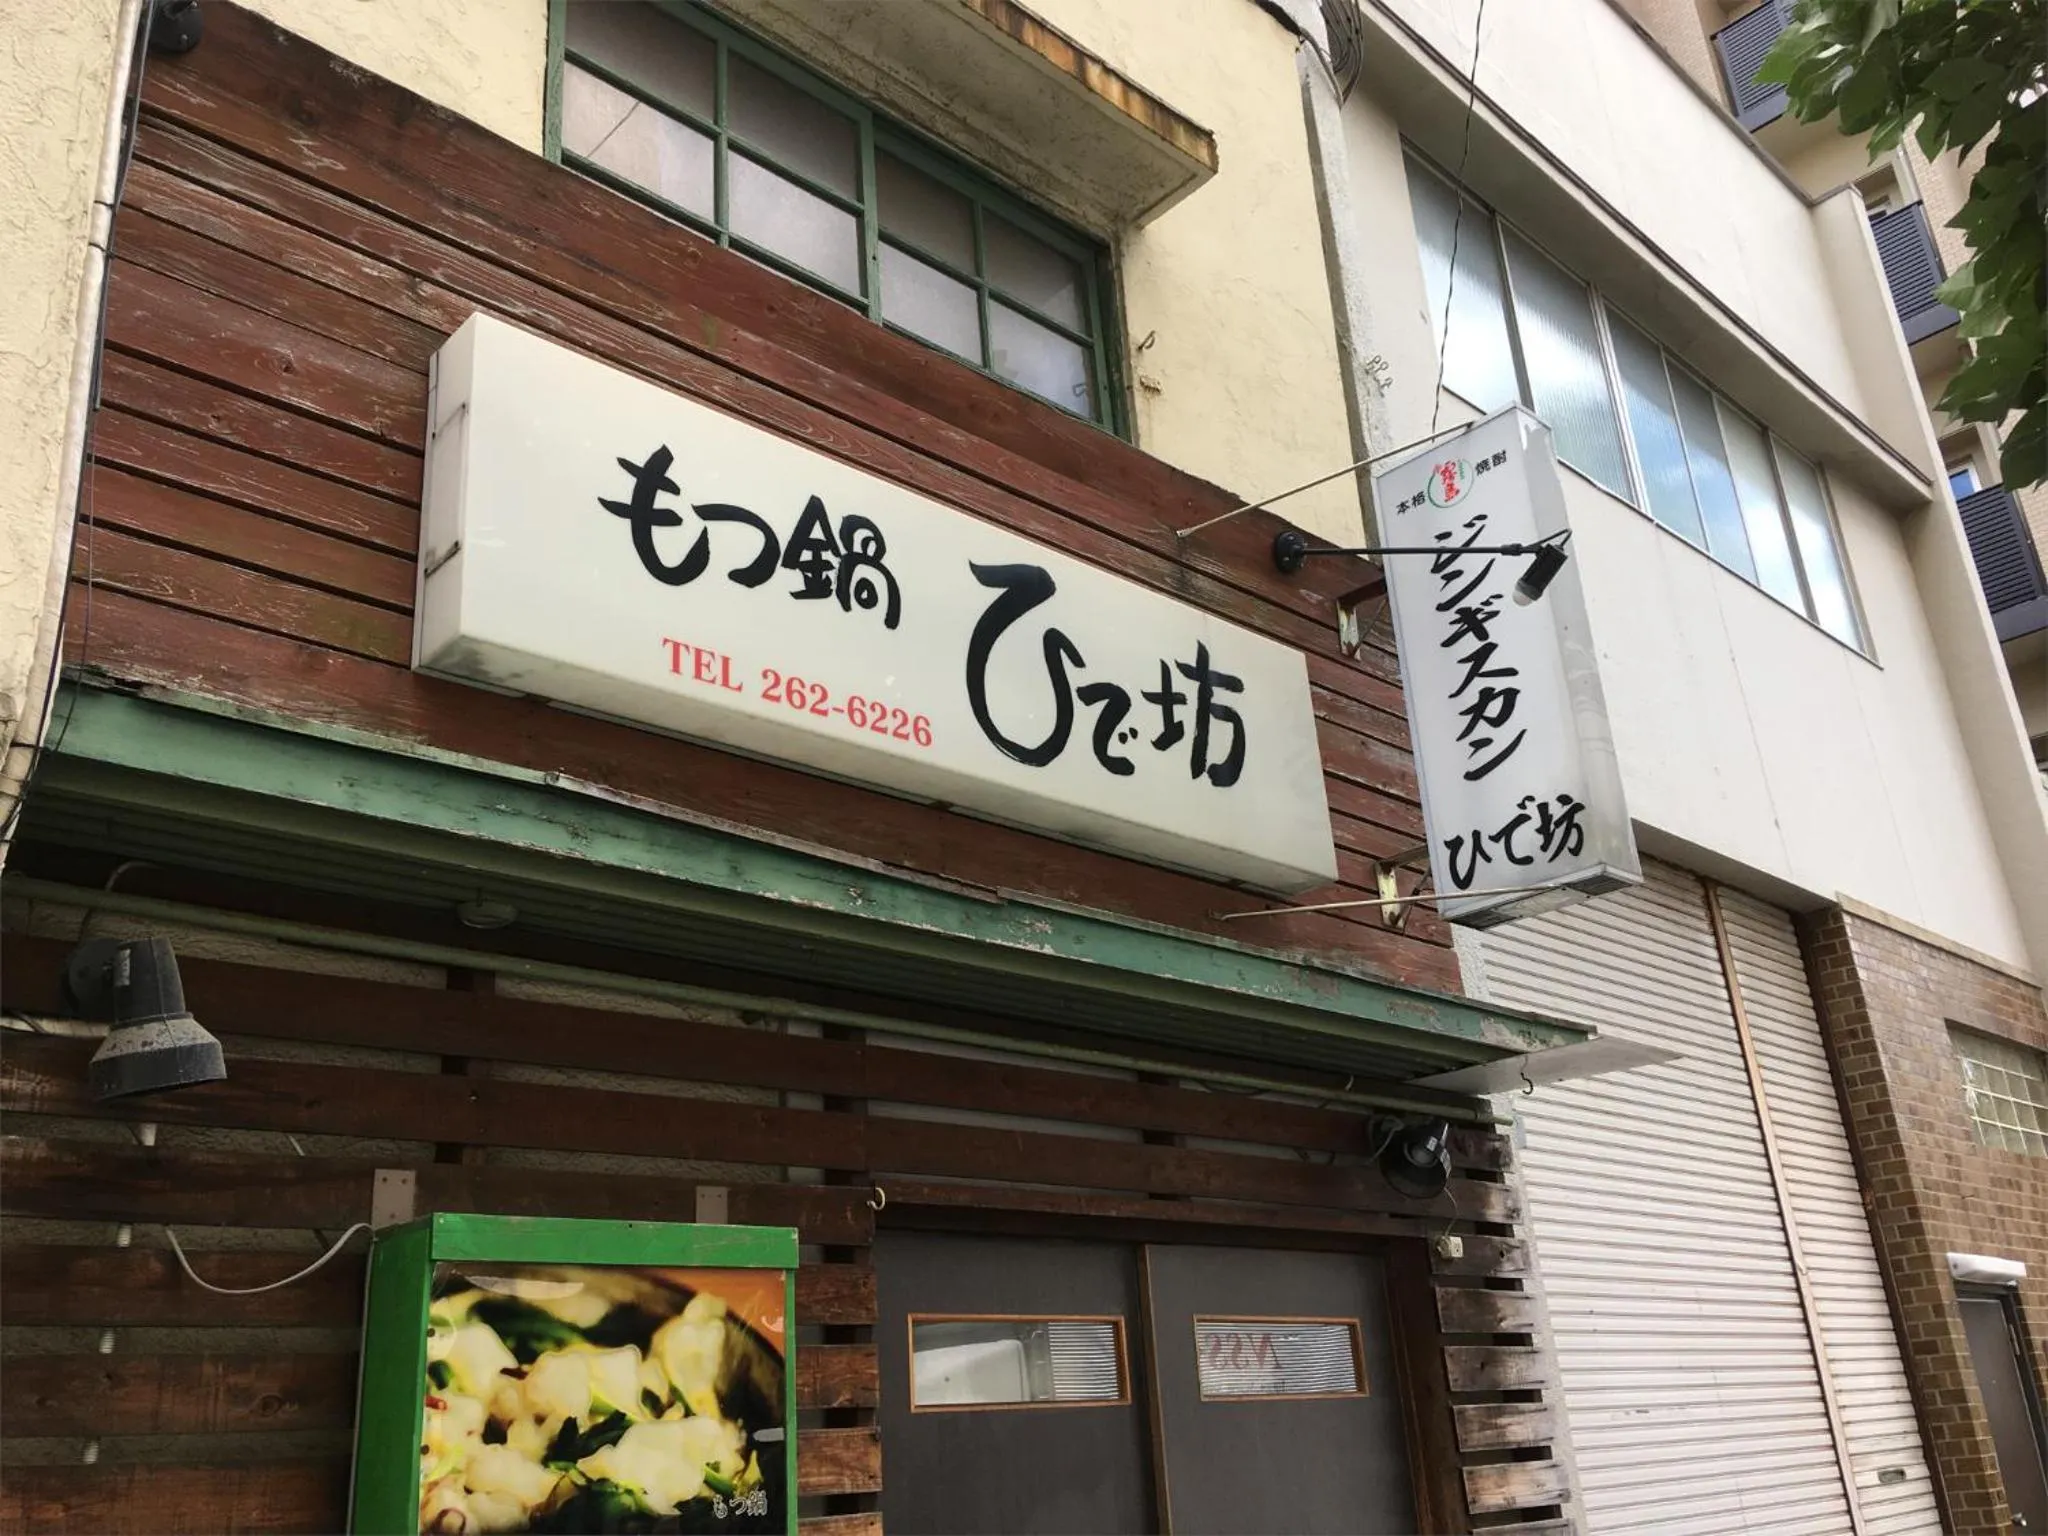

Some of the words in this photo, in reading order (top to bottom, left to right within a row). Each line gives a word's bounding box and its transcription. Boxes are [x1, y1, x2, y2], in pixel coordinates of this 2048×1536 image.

[1396, 491, 1426, 515] 本格
[1475, 449, 1507, 476] 焼酎
[597, 444, 902, 631] もつ鍋
[966, 559, 1246, 788] ひで坊
[1430, 514, 1528, 781] ジンギスカン
[662, 637, 744, 693] TEL
[760, 668, 934, 748] 262-6226
[1443, 793, 1586, 890] ひで坊
